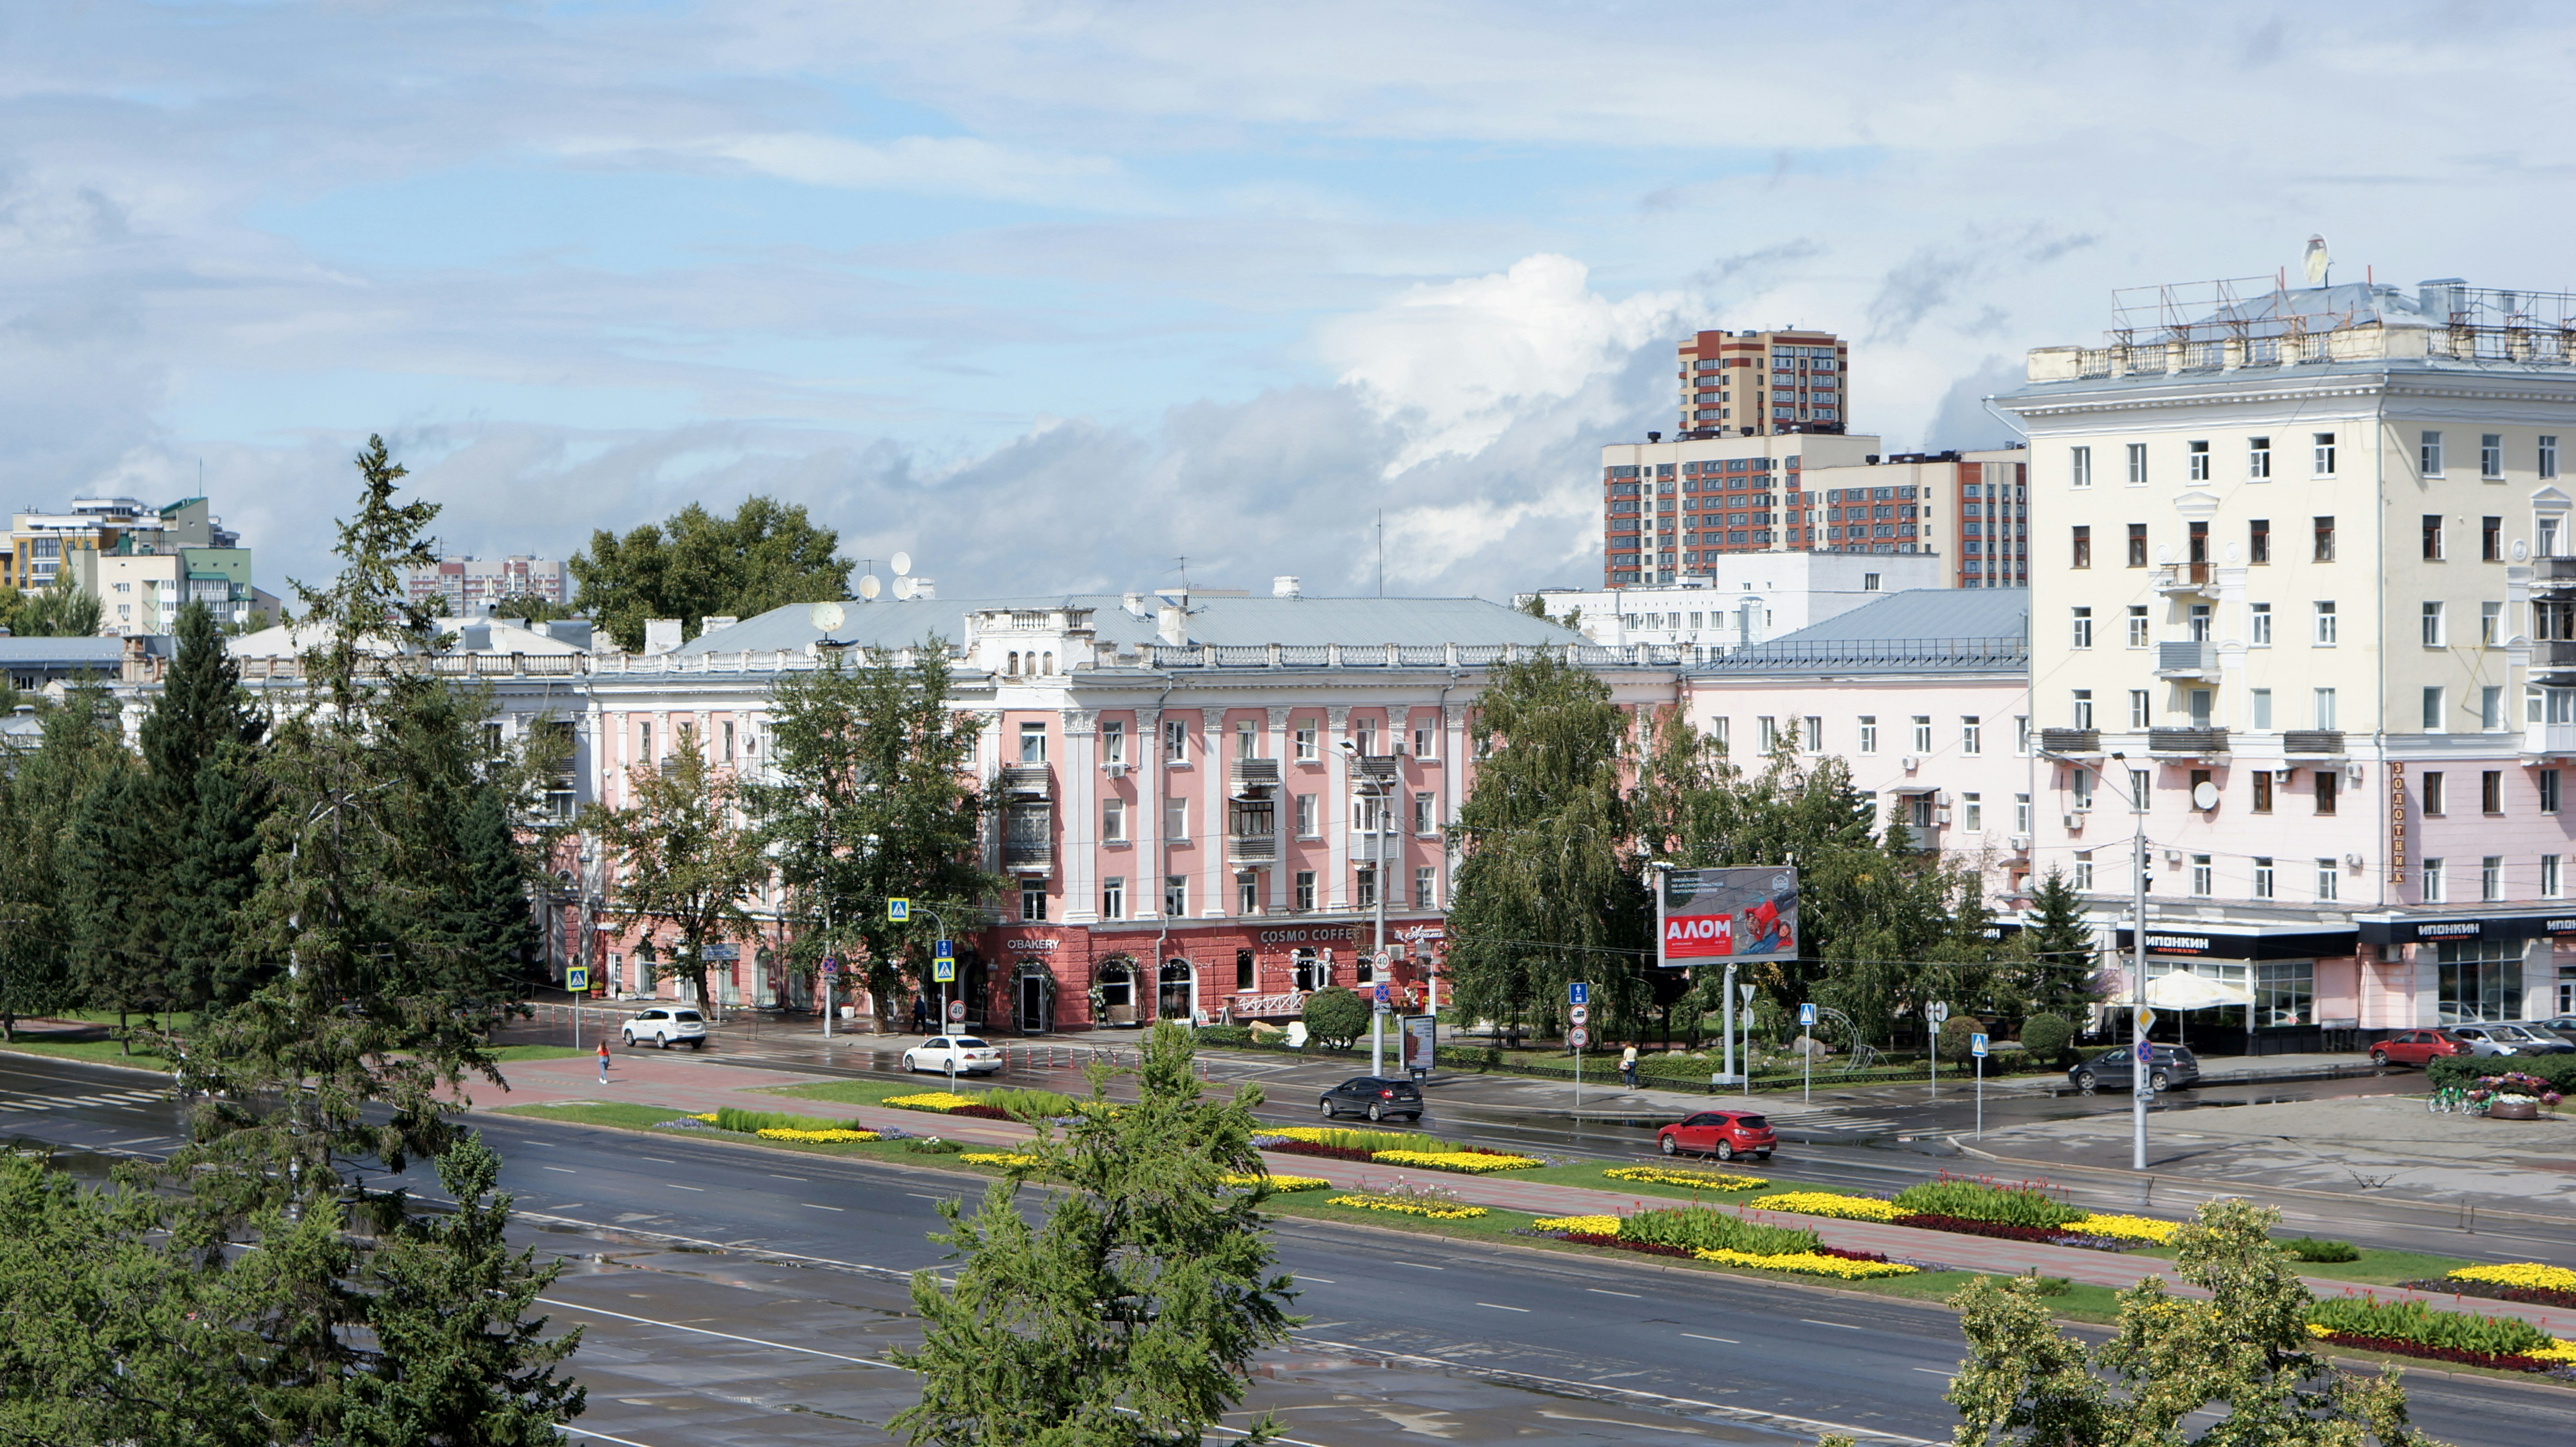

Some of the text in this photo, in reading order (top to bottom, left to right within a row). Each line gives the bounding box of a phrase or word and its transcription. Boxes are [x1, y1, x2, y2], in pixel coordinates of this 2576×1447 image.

[2394, 762, 2403, 882] ЗОЛОТНИК
[1667, 920, 1731, 940] АЛОМ
[2418, 923, 2480, 935] ИПОНКИН
[1260, 930, 1307, 943] COSMO
[2145, 936, 2209, 949] ИПОНКИН
[1007, 940, 1059, 949] O'BAKERY
